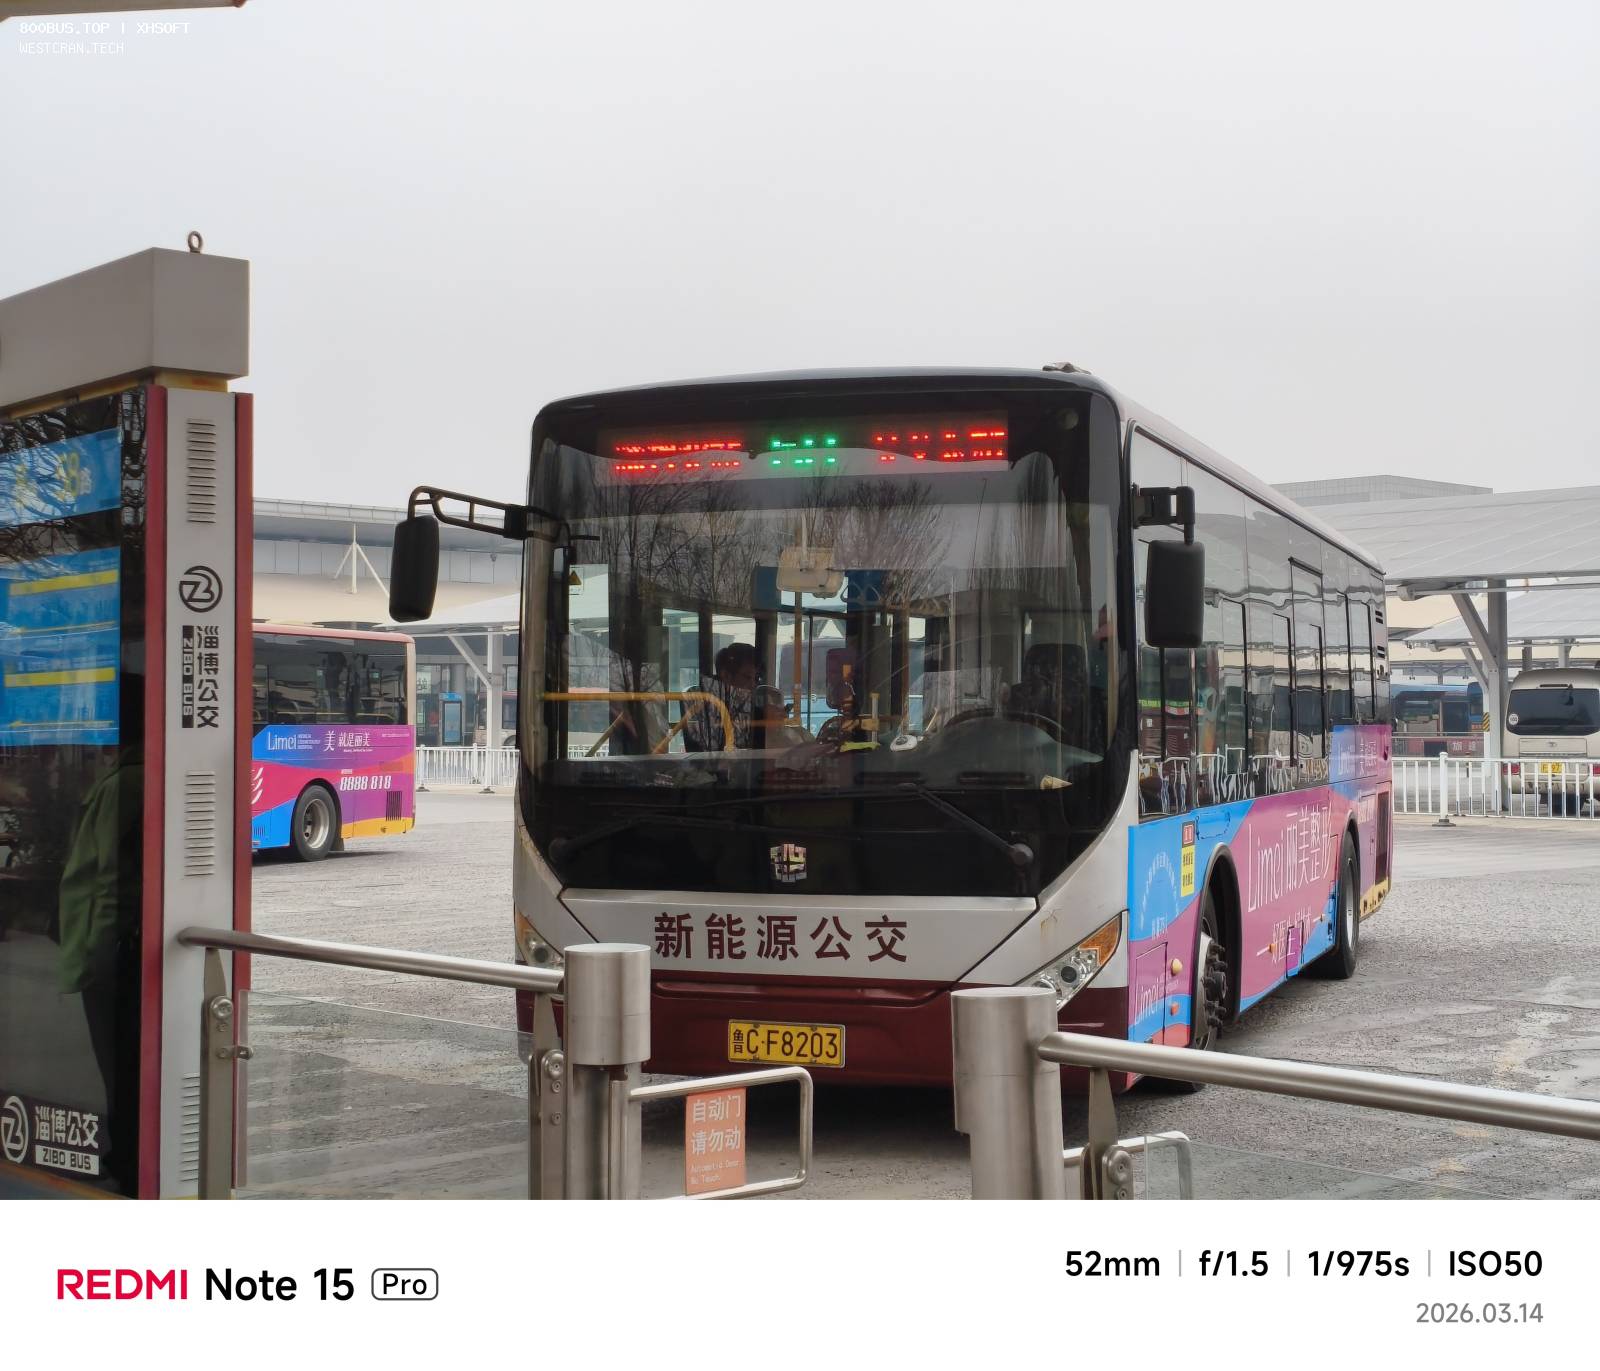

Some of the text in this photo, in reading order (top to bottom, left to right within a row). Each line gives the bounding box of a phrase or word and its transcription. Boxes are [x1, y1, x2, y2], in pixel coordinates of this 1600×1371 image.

[183, 637, 194, 716] ZIBO BUS
[197, 625, 219, 729] 淄博公交
[267, 731, 298, 751] Limei
[323, 730, 336, 752] 美
[1248, 822, 1284, 913] Limei
[1286, 800, 1332, 892] 丽美整形
[654, 912, 907, 963] 新能源公交
[35, 1105, 99, 1149] 淄博公交
[692, 1095, 741, 1122] 自动门
[43, 1148, 91, 1170] ZIBO BUS
[691, 1123, 741, 1156] 请勿动
